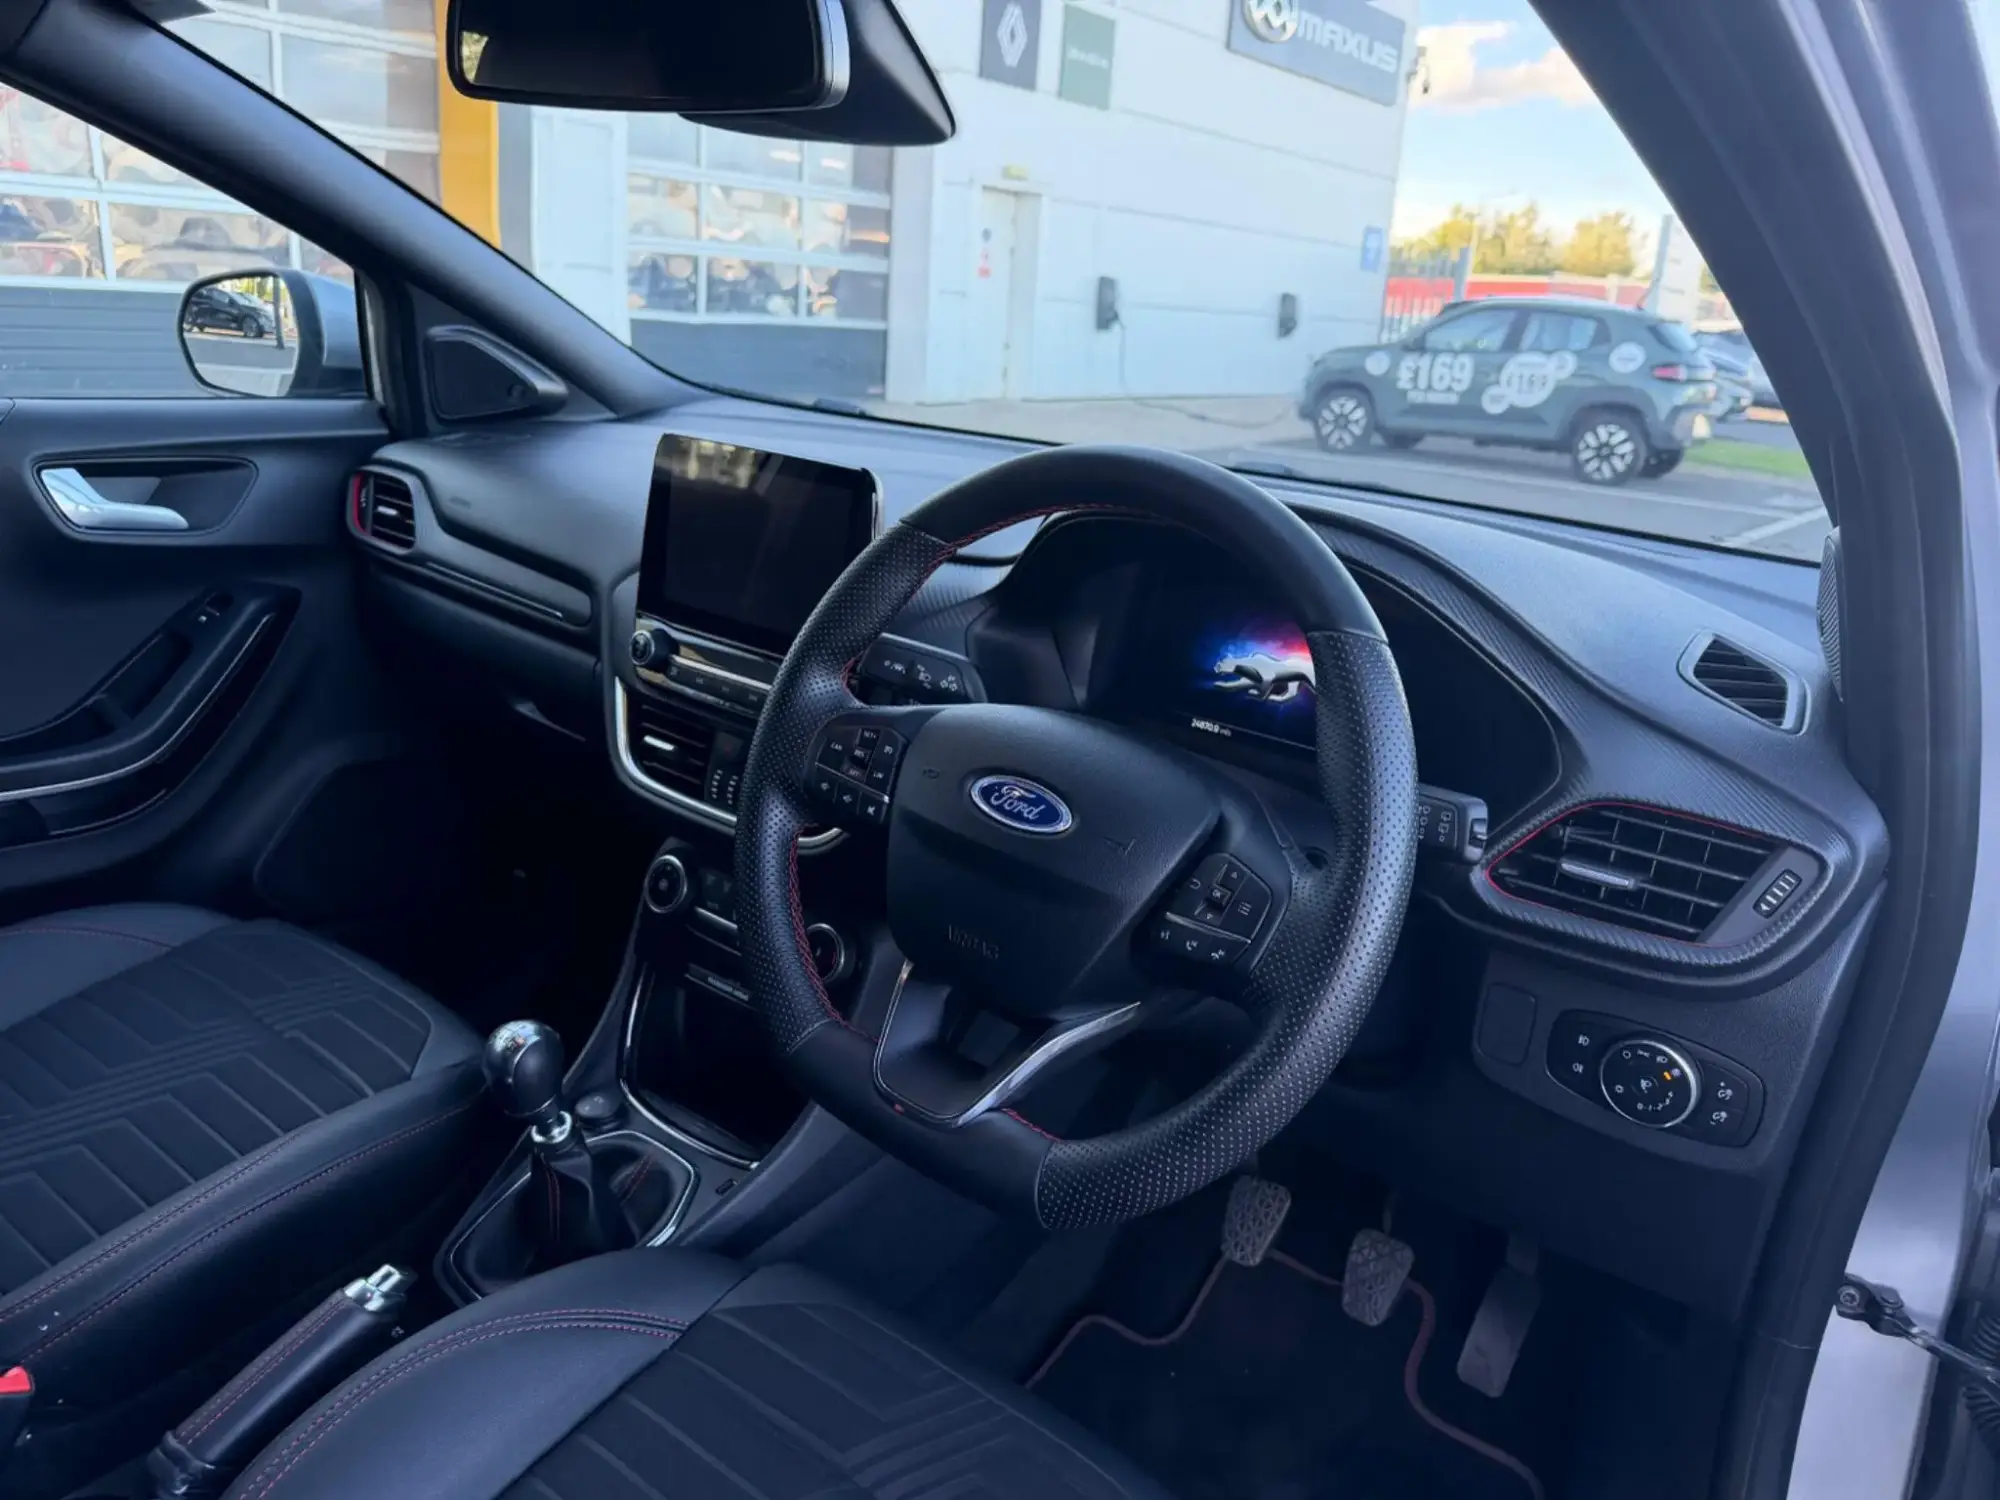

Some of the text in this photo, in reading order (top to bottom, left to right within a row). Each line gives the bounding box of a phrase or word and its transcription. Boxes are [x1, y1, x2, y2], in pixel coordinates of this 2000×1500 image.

[1297, 11, 1399, 73] MAXUS
[1396, 352, 1475, 392] £169
[991, 784, 1045, 820] Ford
